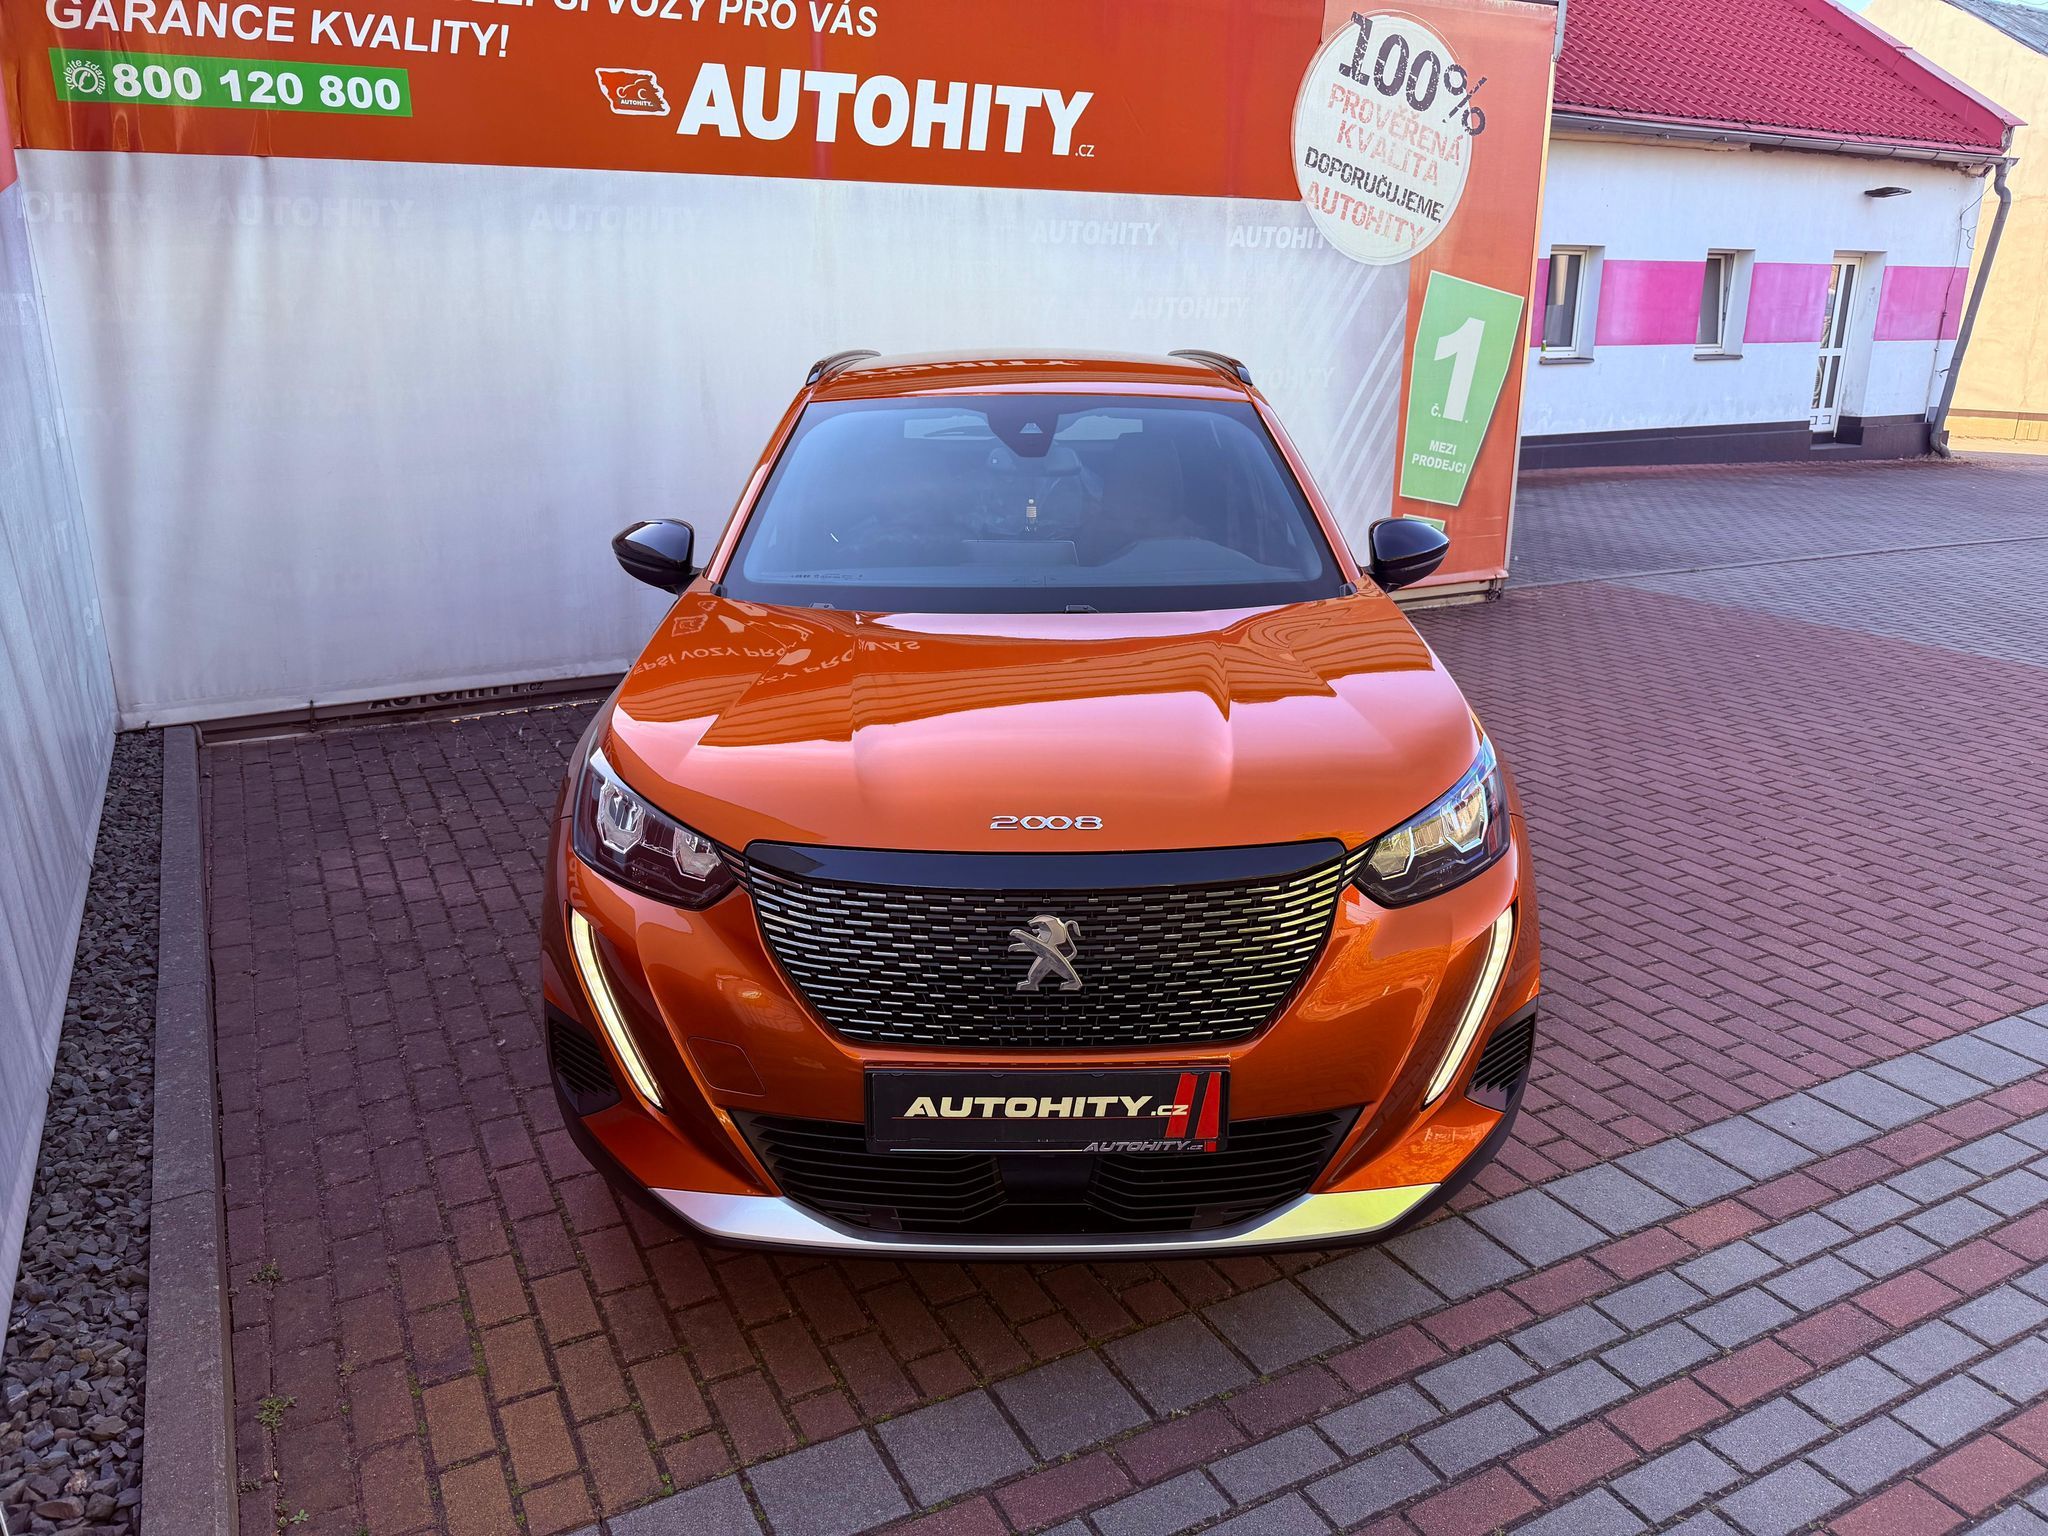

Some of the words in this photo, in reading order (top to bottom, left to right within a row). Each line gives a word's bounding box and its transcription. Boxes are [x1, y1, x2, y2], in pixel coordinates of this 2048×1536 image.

[46, 0, 295, 43] GARANCE
[310, 9, 509, 58] KVALITY!
[718, 0, 797, 30] PRO
[808, 0, 878, 38] VÁS
[63, 59, 82, 90] volejte
[84, 60, 106, 95] zdarma
[113, 63, 202, 101] 800
[219, 69, 304, 105] 120
[319, 75, 401, 110] 800
[1339, 11, 1488, 136] 100%
[1328, 82, 1465, 166] PROVĚŘENÁ
[1336, 120, 1439, 186] KVALITA
[1304, 146, 1445, 223] DOPORUČUJEME
[1229, 225, 1328, 249] AUTOHIT
[1307, 181, 1425, 249] AUTOHITY
[1411, 453, 1467, 474] PRODEJCI
[1429, 440, 1457, 456] MEZI
[989, 815, 1104, 831] 2008
